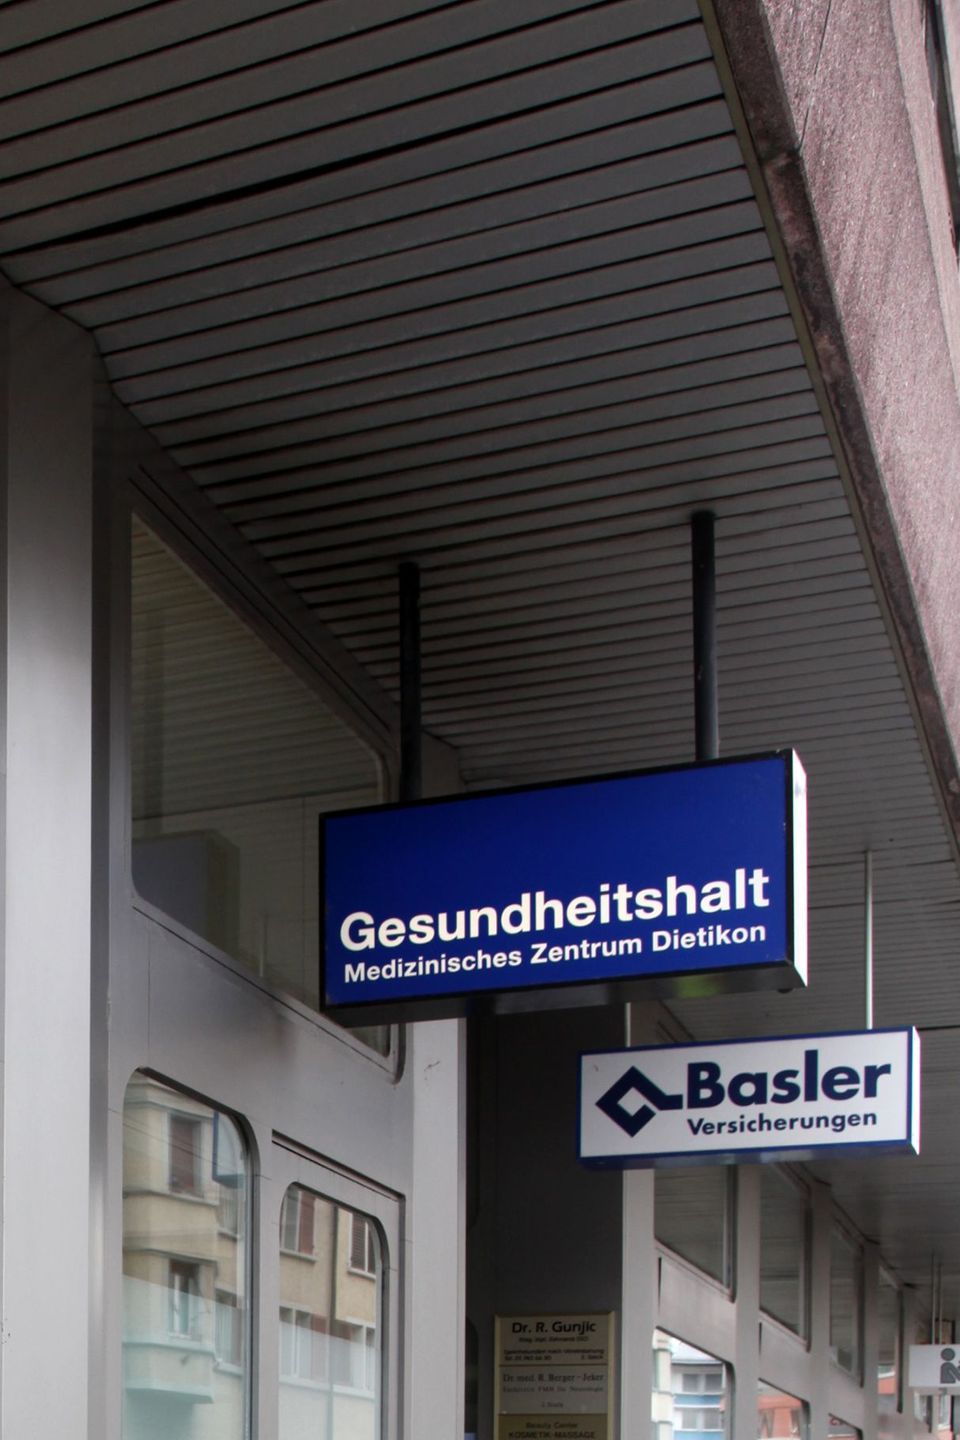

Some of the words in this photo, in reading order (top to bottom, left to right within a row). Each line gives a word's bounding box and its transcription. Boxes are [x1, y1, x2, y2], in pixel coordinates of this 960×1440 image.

[340, 867, 770, 952] Gesundheitshalt
[344, 948, 523, 984] Medizinisches
[530, 937, 643, 965] Zentrum
[652, 922, 767, 953] Dietikon
[686, 1049, 892, 1110] Basler
[686, 1112, 878, 1138] Versicherungen
[512, 1322, 532, 1334] Dr.
[536, 1321, 548, 1333] R.
